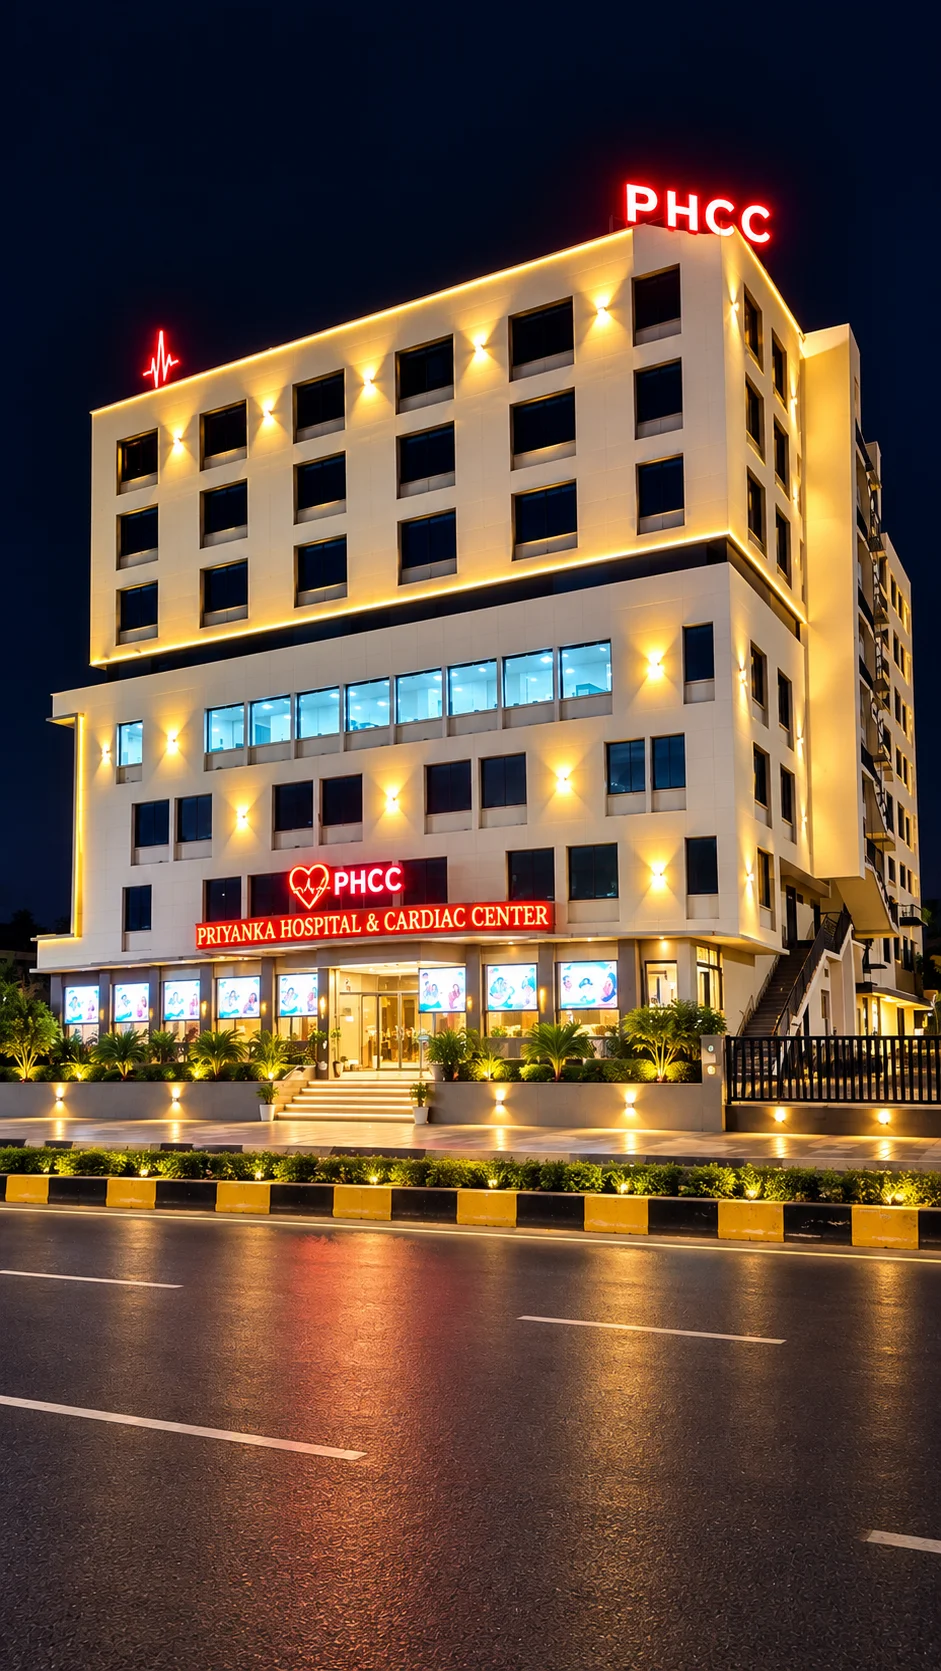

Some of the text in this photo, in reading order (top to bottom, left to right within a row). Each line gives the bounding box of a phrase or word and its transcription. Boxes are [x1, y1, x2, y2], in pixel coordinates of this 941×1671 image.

[626, 183, 771, 243] PHCC
[334, 867, 402, 896] PHCC
[197, 905, 549, 945] PRIYANKA HOSPITAL & CARDIAC CENTER
